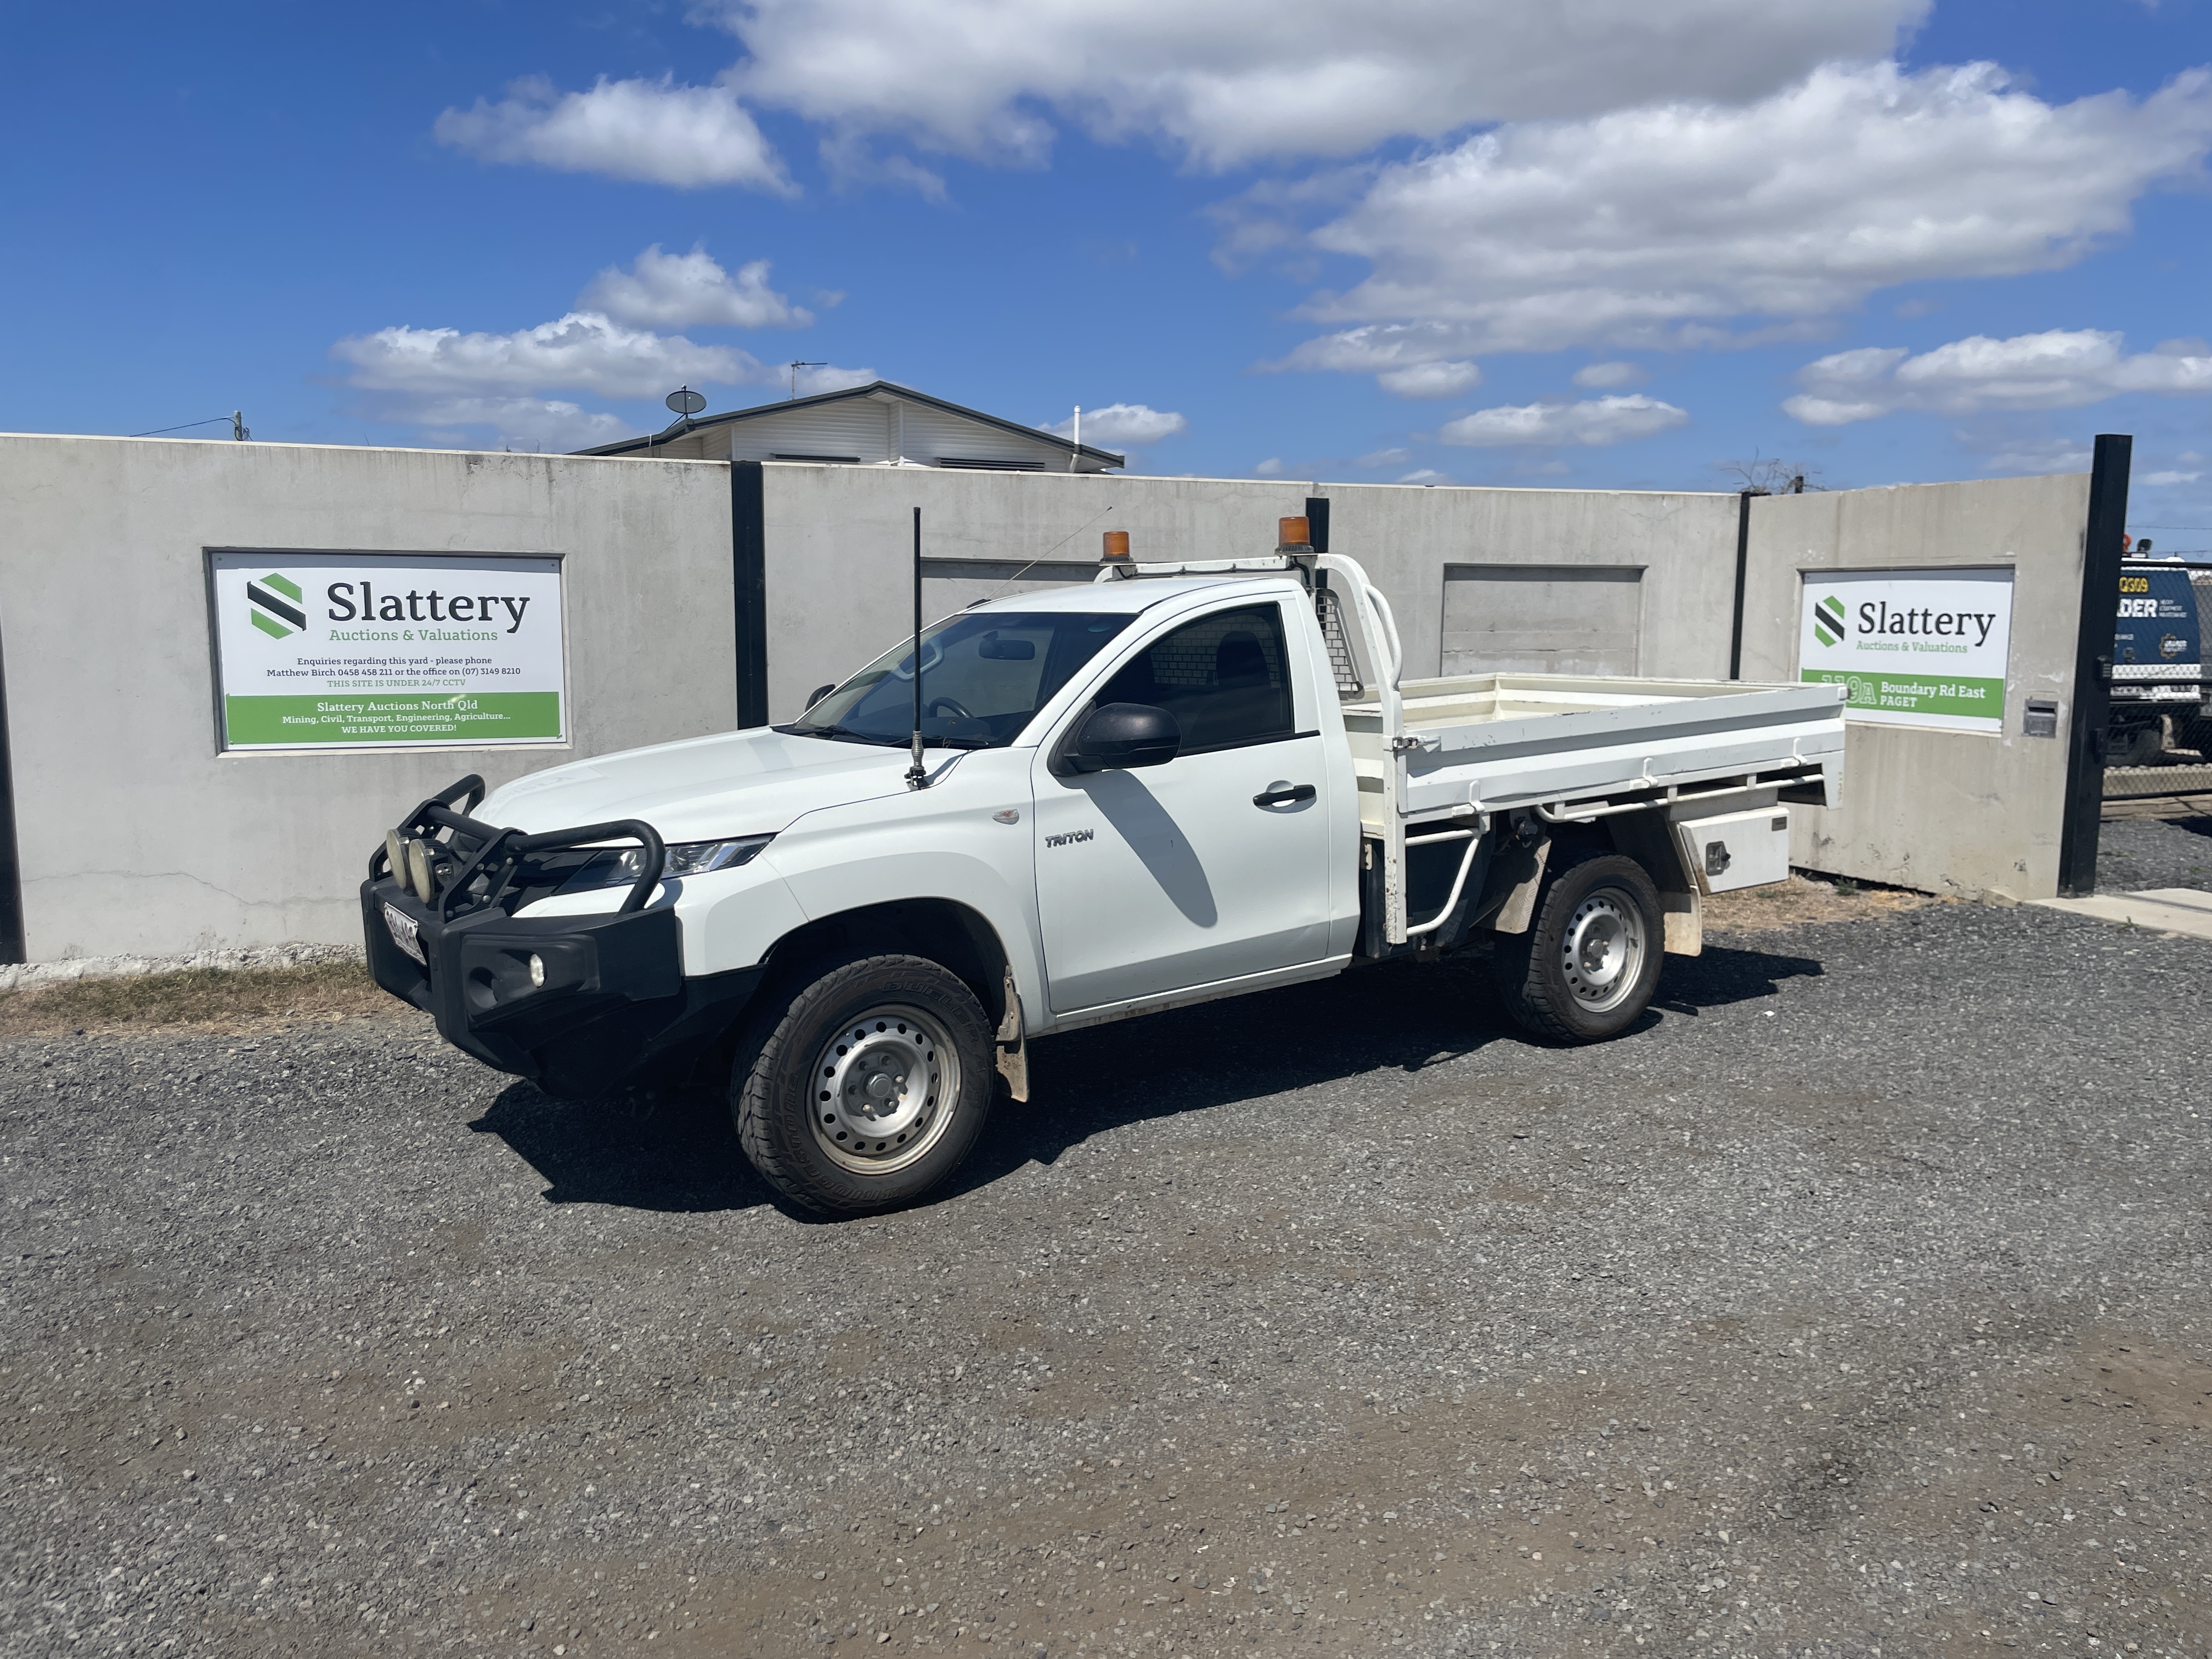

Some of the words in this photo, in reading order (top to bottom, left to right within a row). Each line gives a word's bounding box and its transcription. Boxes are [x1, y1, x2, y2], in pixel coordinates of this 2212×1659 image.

[328, 582, 530, 634] Slattery
[2117, 598, 2158, 618] DER
[1858, 601, 1996, 647] Slattery
[329, 629, 398, 641] Auctions
[403, 629, 414, 641] &
[417, 628, 498, 641] Valuations
[1856, 640, 1899, 651] Auctions
[1901, 641, 1909, 652] &
[1912, 641, 1968, 653] Valuations
[297, 658, 341, 667] Enquiries
[343, 657, 387, 667] regarding
[408, 657, 428, 666] yard
[436, 657, 464, 666] please
[464, 656, 492, 665] phone
[311, 668, 336, 676] Birch
[422, 667, 447, 675] office
[462, 667, 479, 676] (07)
[1821, 675, 1878, 705] 9A
[1881, 681, 1937, 698] Boundary
[1939, 684, 1956, 697] Rd
[1958, 685, 1985, 699] East
[317, 702, 365, 714] Slattery
[367, 701, 419, 711] Auctions
[421, 699, 455, 710] North
[458, 699, 478, 712] Qld
[1880, 695, 1917, 708] PAGET
[283, 715, 319, 725] Mining,
[321, 714, 345, 724] Civil,
[346, 715, 394, 724] Transport,
[396, 713, 453, 723] Engineering,
[359, 725, 386, 733] HAVE
[410, 724, 457, 732] COVERED!
[1045, 828, 1094, 848] TRITON
